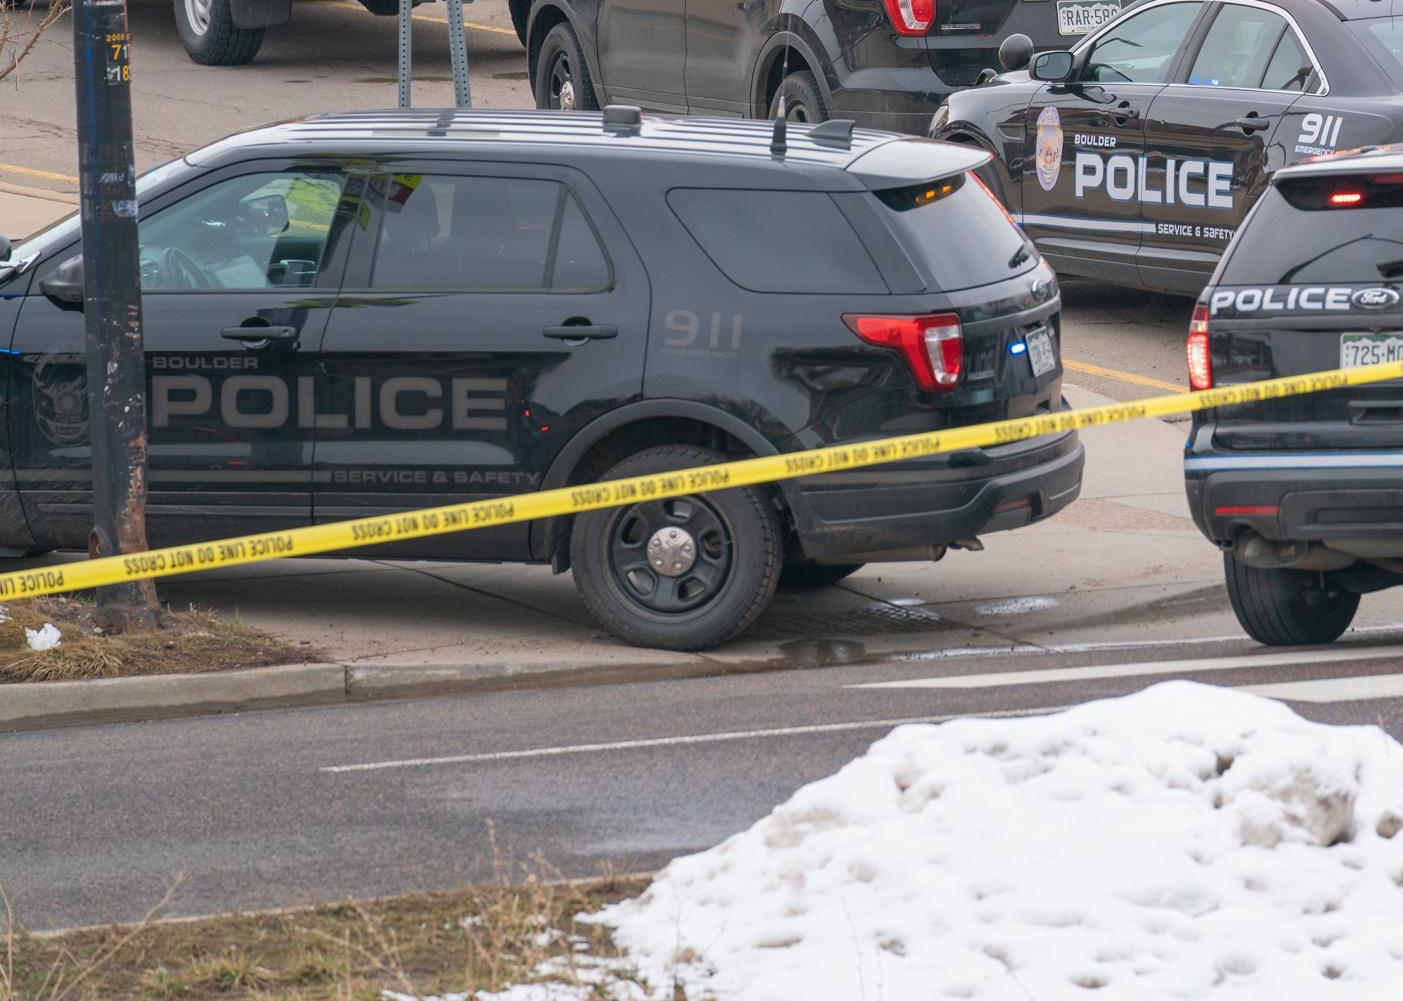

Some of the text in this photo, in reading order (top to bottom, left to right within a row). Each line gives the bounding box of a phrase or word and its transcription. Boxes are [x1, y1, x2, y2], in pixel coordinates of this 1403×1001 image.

[1074, 133, 1117, 148] BOULDER
[1298, 112, 1344, 147] 911
[1075, 153, 1234, 208] POLICE
[1157, 223, 1193, 237] SERVICE
[1212, 287, 1353, 315] POLICE
[1361, 289, 1388, 305] Ford
[664, 309, 744, 350] 911
[152, 356, 258, 370] BOULDER
[151, 374, 508, 431] POLICE
[784, 435, 940, 473] POLICE LINE DO NOT CROSS
[333, 470, 430, 484] SERVICE
[451, 471, 542, 486] SAFETY
[571, 468, 730, 506] POLICE LINE DO NOT CROSS
[351, 500, 514, 540] POLICE LINE DO NOT CROSS
[124, 534, 293, 576] POLICE LINE DO NOT CROSS
[20, 569, 64, 591] POLICE
